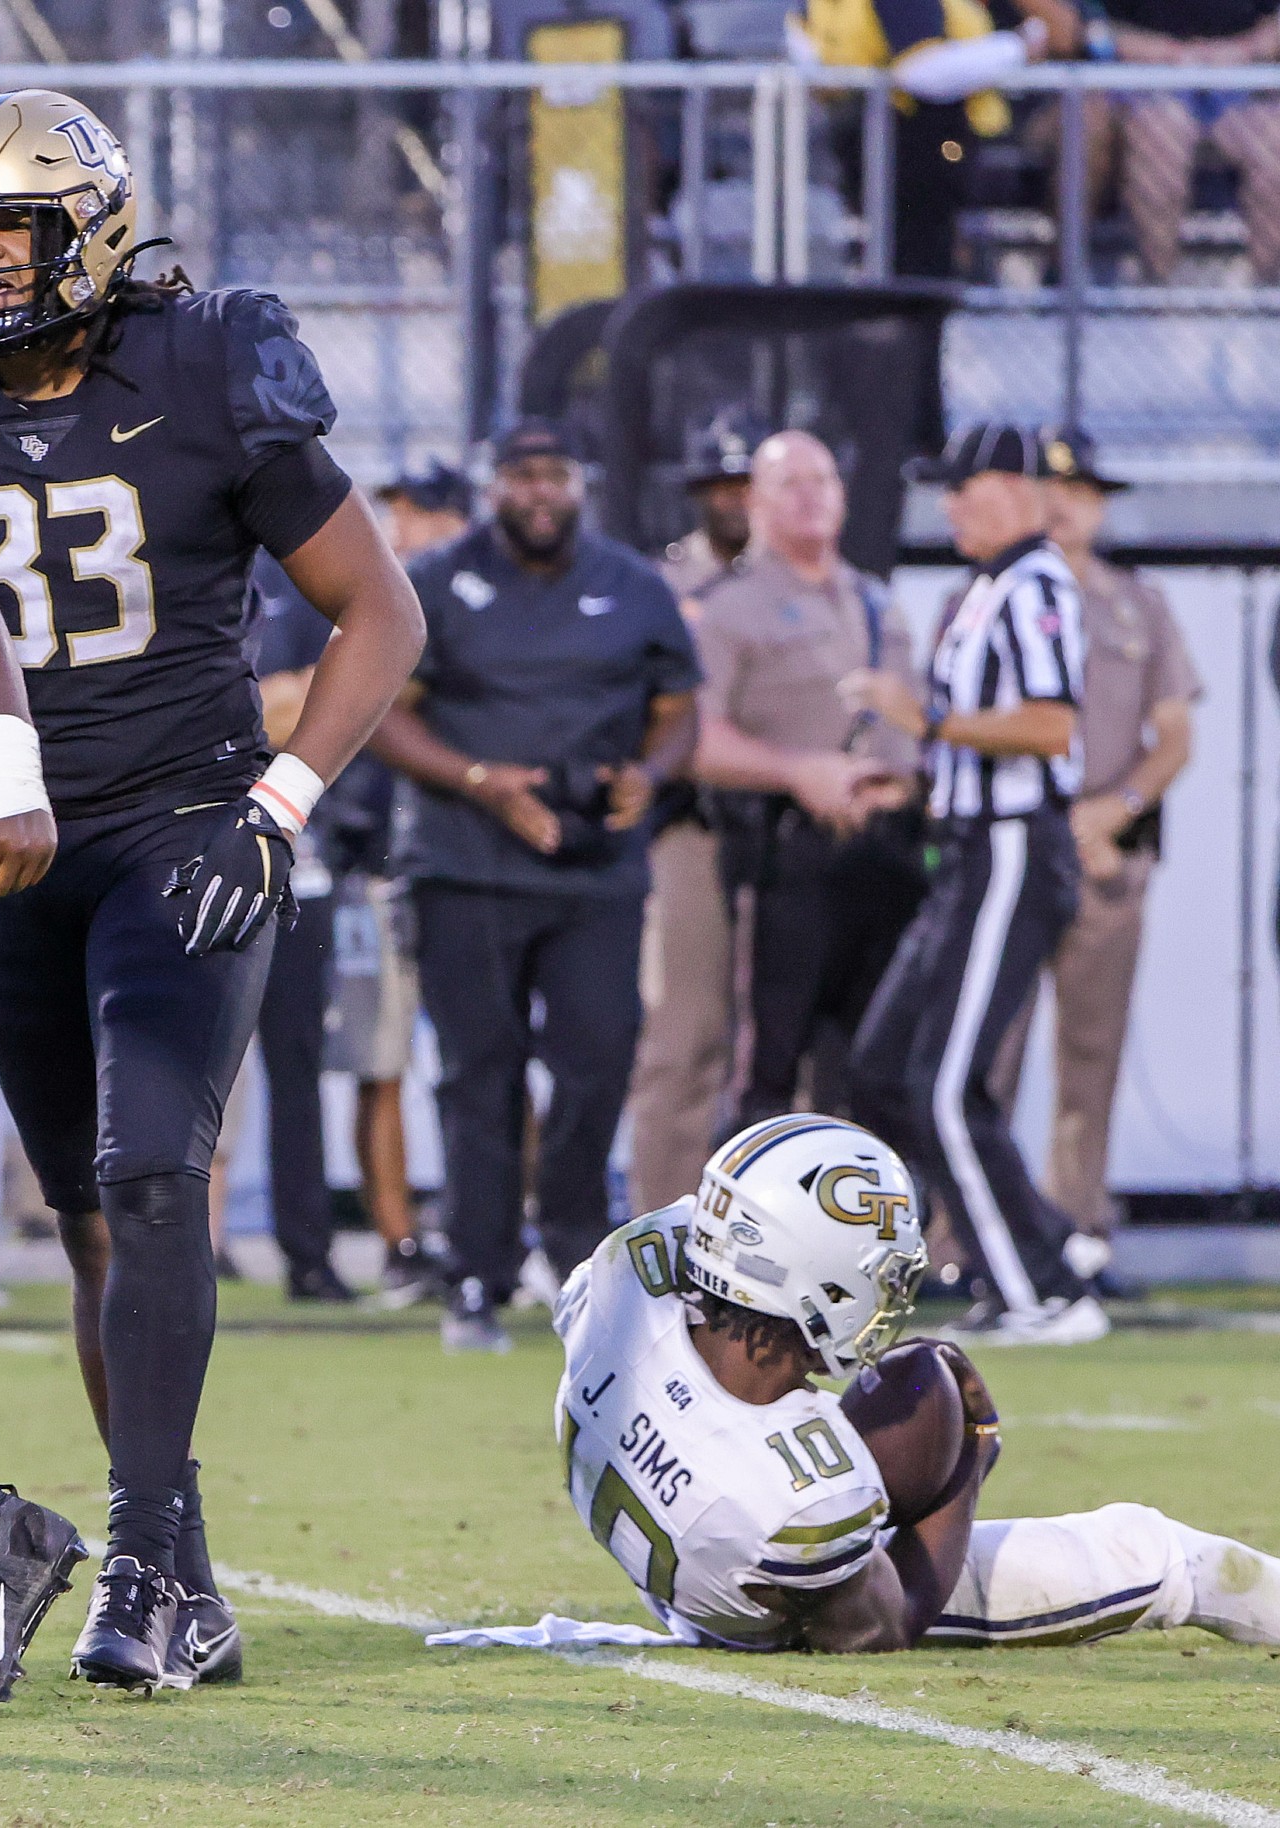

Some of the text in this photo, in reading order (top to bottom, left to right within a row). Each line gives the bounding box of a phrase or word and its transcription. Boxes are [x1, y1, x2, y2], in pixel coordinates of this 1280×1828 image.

[19, 435, 49, 461] UCF
[703, 1180, 733, 1221] 10
[817, 1165, 909, 1241] GT
[582, 1372, 691, 1507] J. SIMS
[766, 1417, 855, 1492] 10
